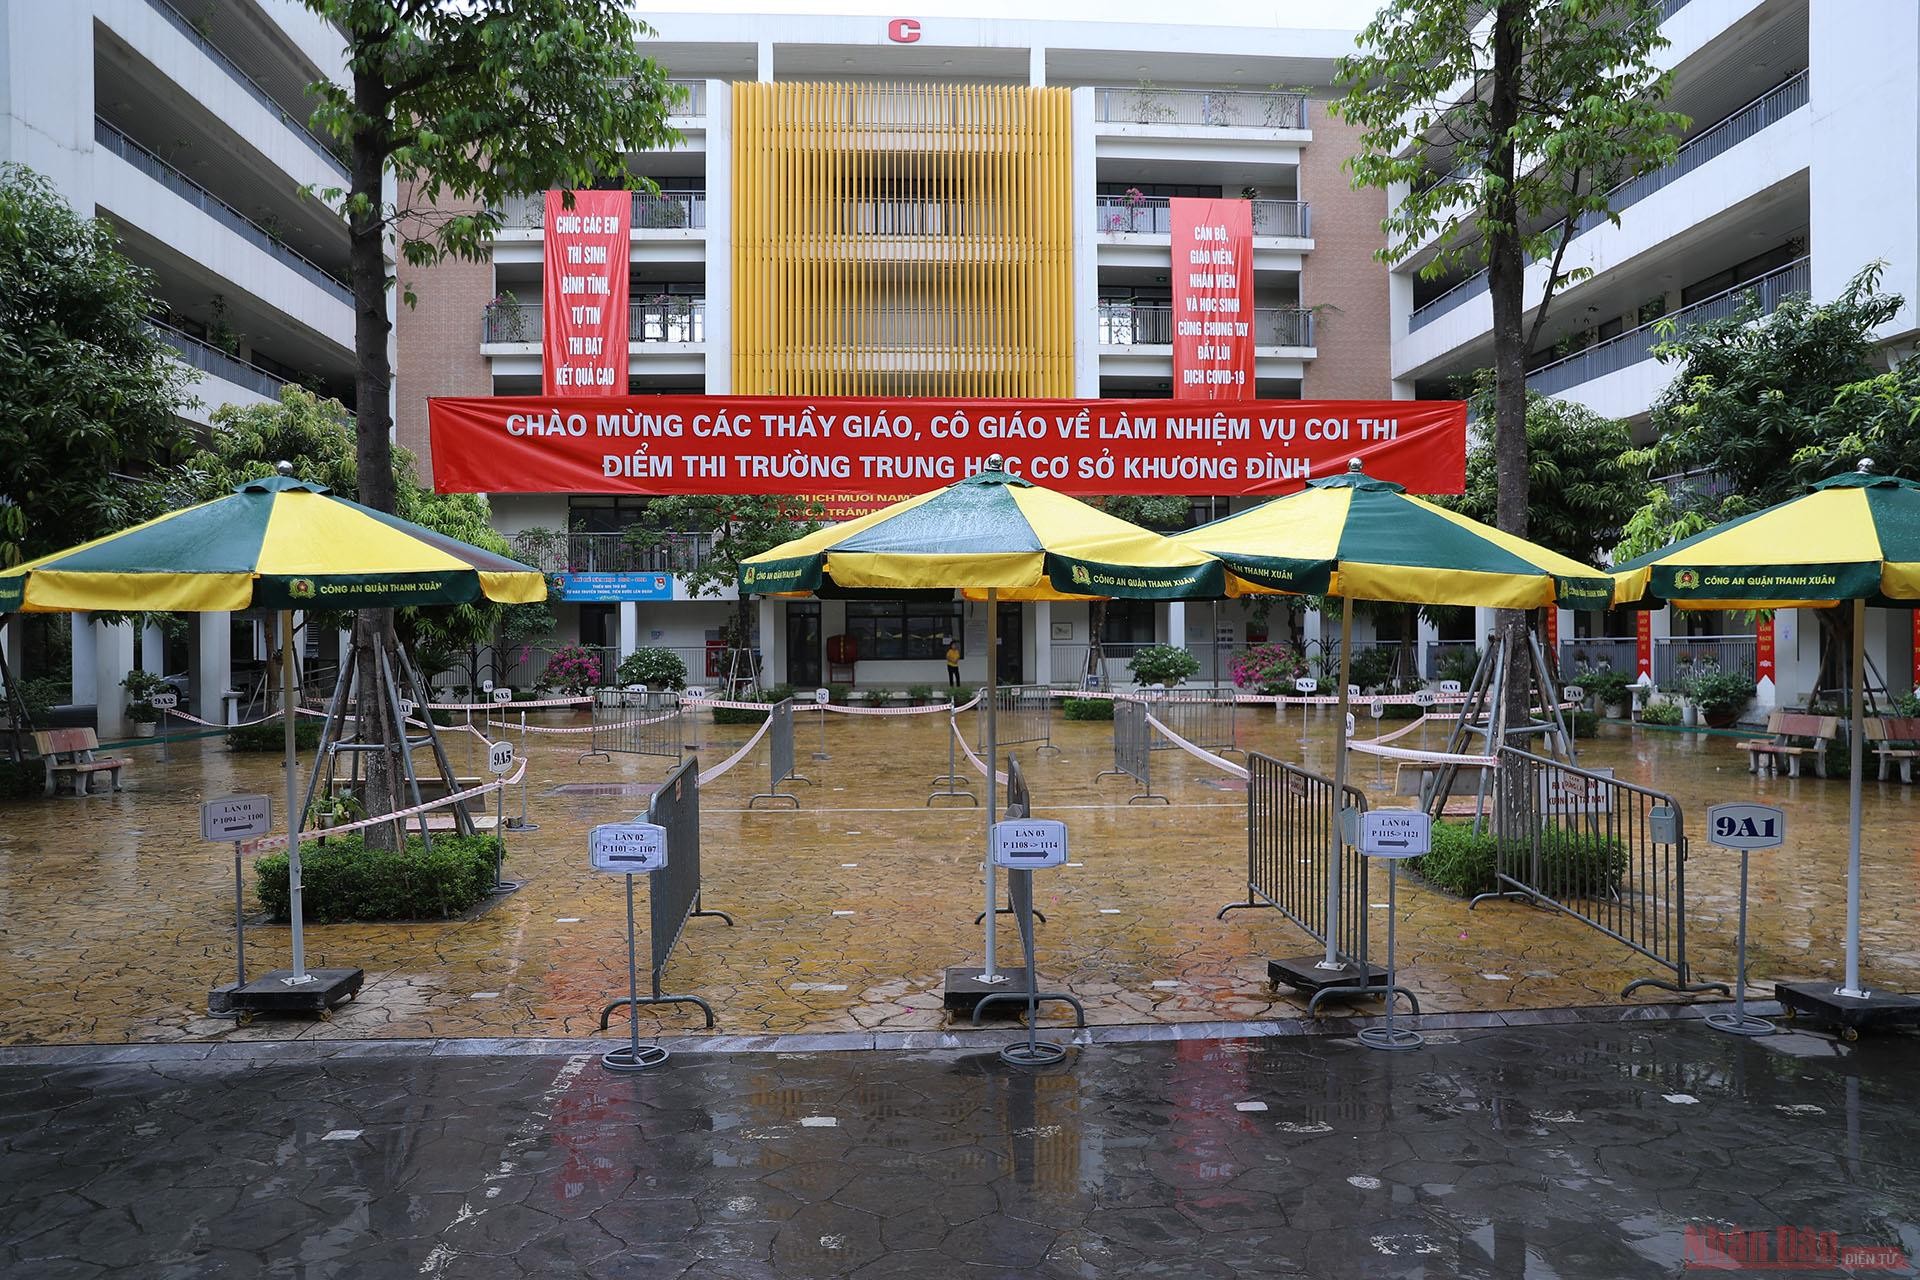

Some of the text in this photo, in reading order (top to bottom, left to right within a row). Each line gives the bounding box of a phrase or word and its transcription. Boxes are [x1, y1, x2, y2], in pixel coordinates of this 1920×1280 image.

[888, 19, 920, 43] C
[557, 214, 618, 234] CHÚC CÁC EM
[1195, 225, 1228, 244] CÁN BỘ,
[568, 243, 606, 264] THÍ SINH
[1190, 248, 1234, 267] GIÁO VIÊN,
[562, 274, 610, 297] BÌNH TĨNH,
[1190, 272, 1235, 288] NHÂN VIÊN
[1186, 296, 1239, 316] VÀ HỌC SINH
[572, 306, 600, 328] TỰ TIN
[1178, 319, 1248, 336] CÙNG CHUNG TAY
[569, 337, 603, 358] THI ĐẠT
[1198, 340, 1230, 360] ĐẨY LÙI
[556, 361, 614, 388] KẾT QUẢ CAO
[1184, 370, 1244, 388] DỊCH COVID-19
[506, 406, 1398, 446] CHÀO MỪNG CÁC THẦY GIÁO, CÔ GIÁO VỀ LÀM NHIỆM VỤ COI THI
[602, 442, 672, 477] ĐIỂM
[682, 456, 725, 477] THI
[735, 449, 850, 478] TRƯỜNG
[859, 456, 954, 478] TRUNG
[1031, 455, 1069, 479] CƠ
[1078, 448, 1115, 479] SỞ
[1125, 455, 1238, 479] KHƯƠNG
[1246, 452, 1310, 478] ĐÌNH
[1093, 575, 1196, 589] CÔNG AN QUẬN THANH XUÂN
[1244, 567, 1269, 577] THANH
[1271, 570, 1292, 580] XUÂN
[1704, 574, 1835, 587] CÔNG AN QUẬN THANH XUÂN
[321, 582, 442, 594] CÔNG AN QUẬN THANH XUÂN
[494, 750, 511, 766] 9A5
[220, 816, 236, 824] 1094
[1716, 816, 1778, 837] 9A1
[1016, 828, 1034, 837] LÀN
